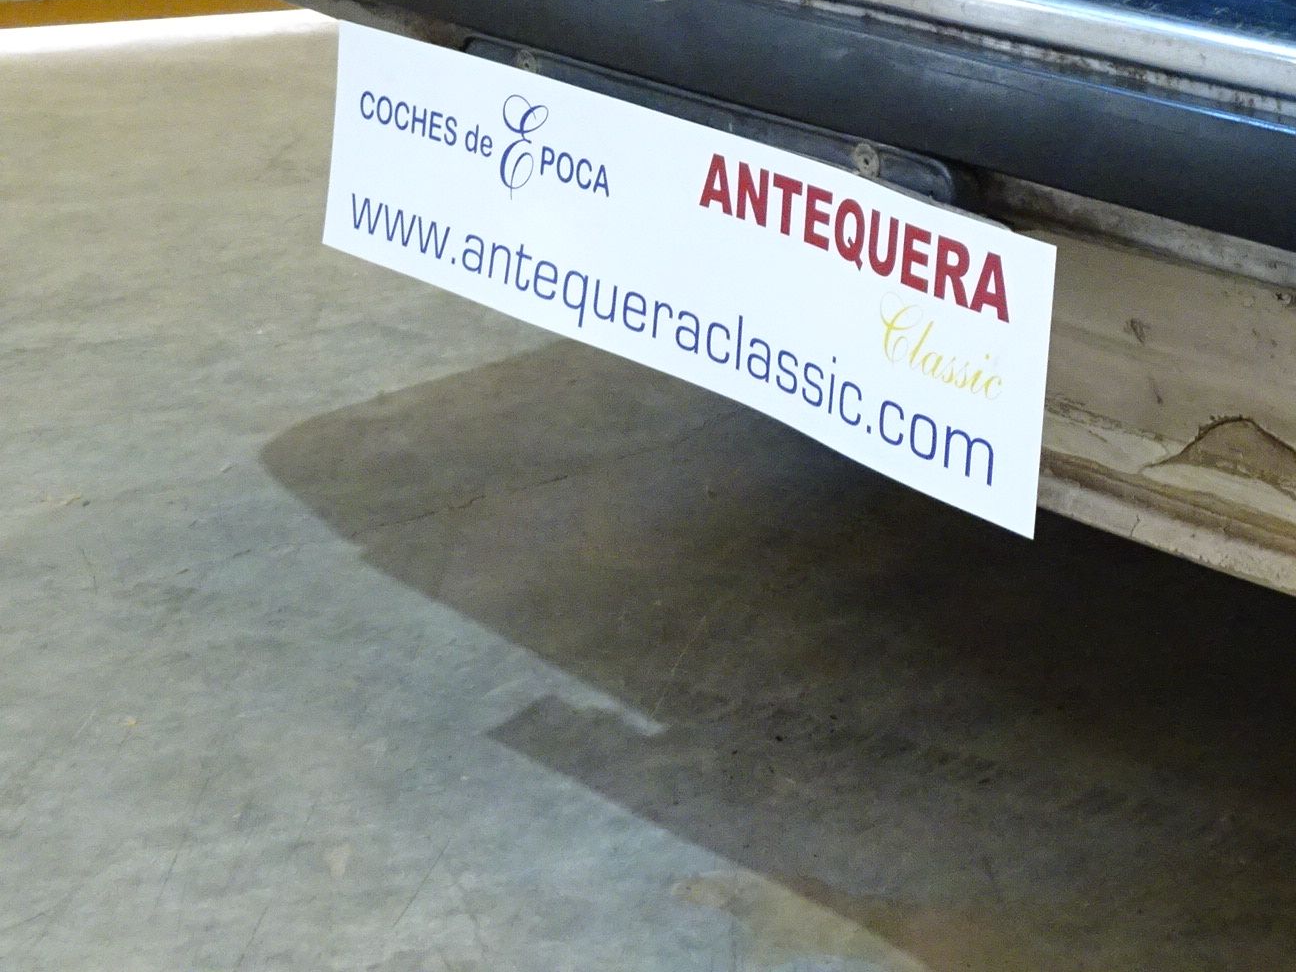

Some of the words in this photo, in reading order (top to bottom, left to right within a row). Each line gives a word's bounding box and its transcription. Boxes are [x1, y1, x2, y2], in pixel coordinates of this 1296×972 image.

[359, 90, 458, 147] COCHES
[464, 123, 494, 158] de
[698, 152, 1010, 324] ANTEQUERA
[351, 192, 995, 488] www.antequeraclassic.com
[879, 291, 1003, 401] Classic
